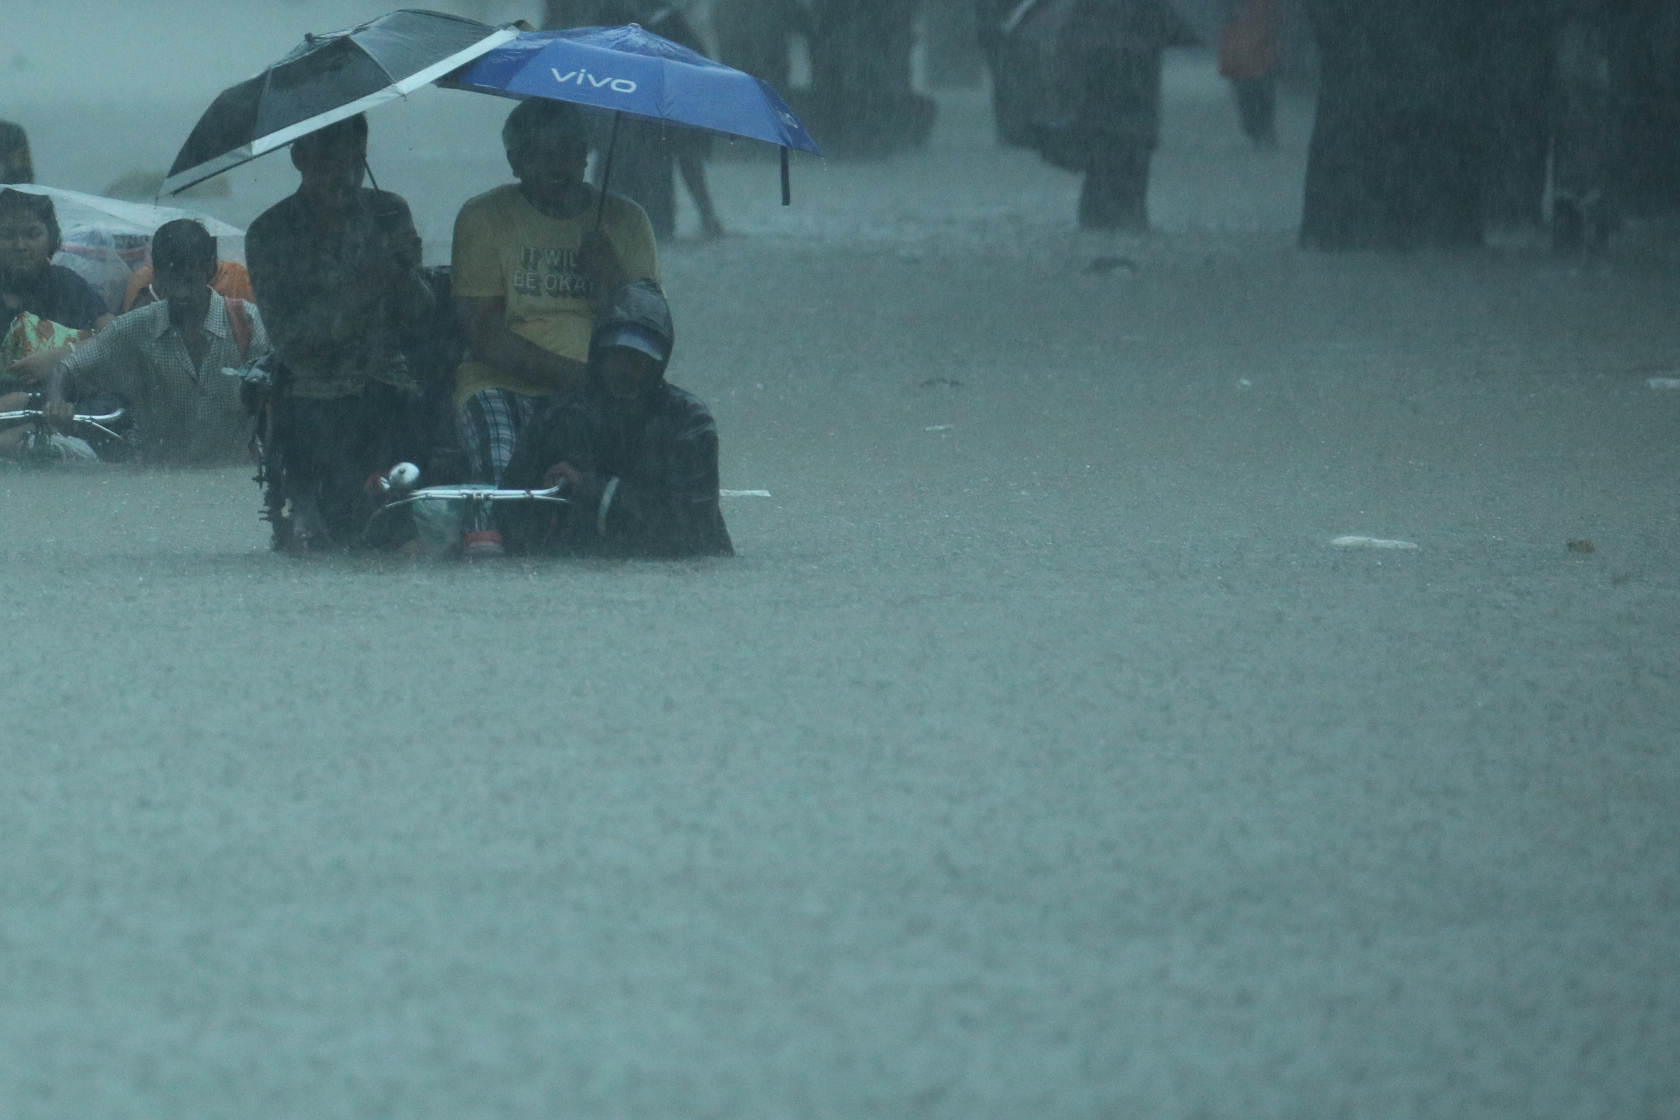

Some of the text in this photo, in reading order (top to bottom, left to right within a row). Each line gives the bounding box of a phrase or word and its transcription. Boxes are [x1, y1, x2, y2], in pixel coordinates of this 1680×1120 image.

[551, 68, 637, 93] vivo
[520, 245, 581, 270] IT WIL
[513, 269, 538, 292] BE
